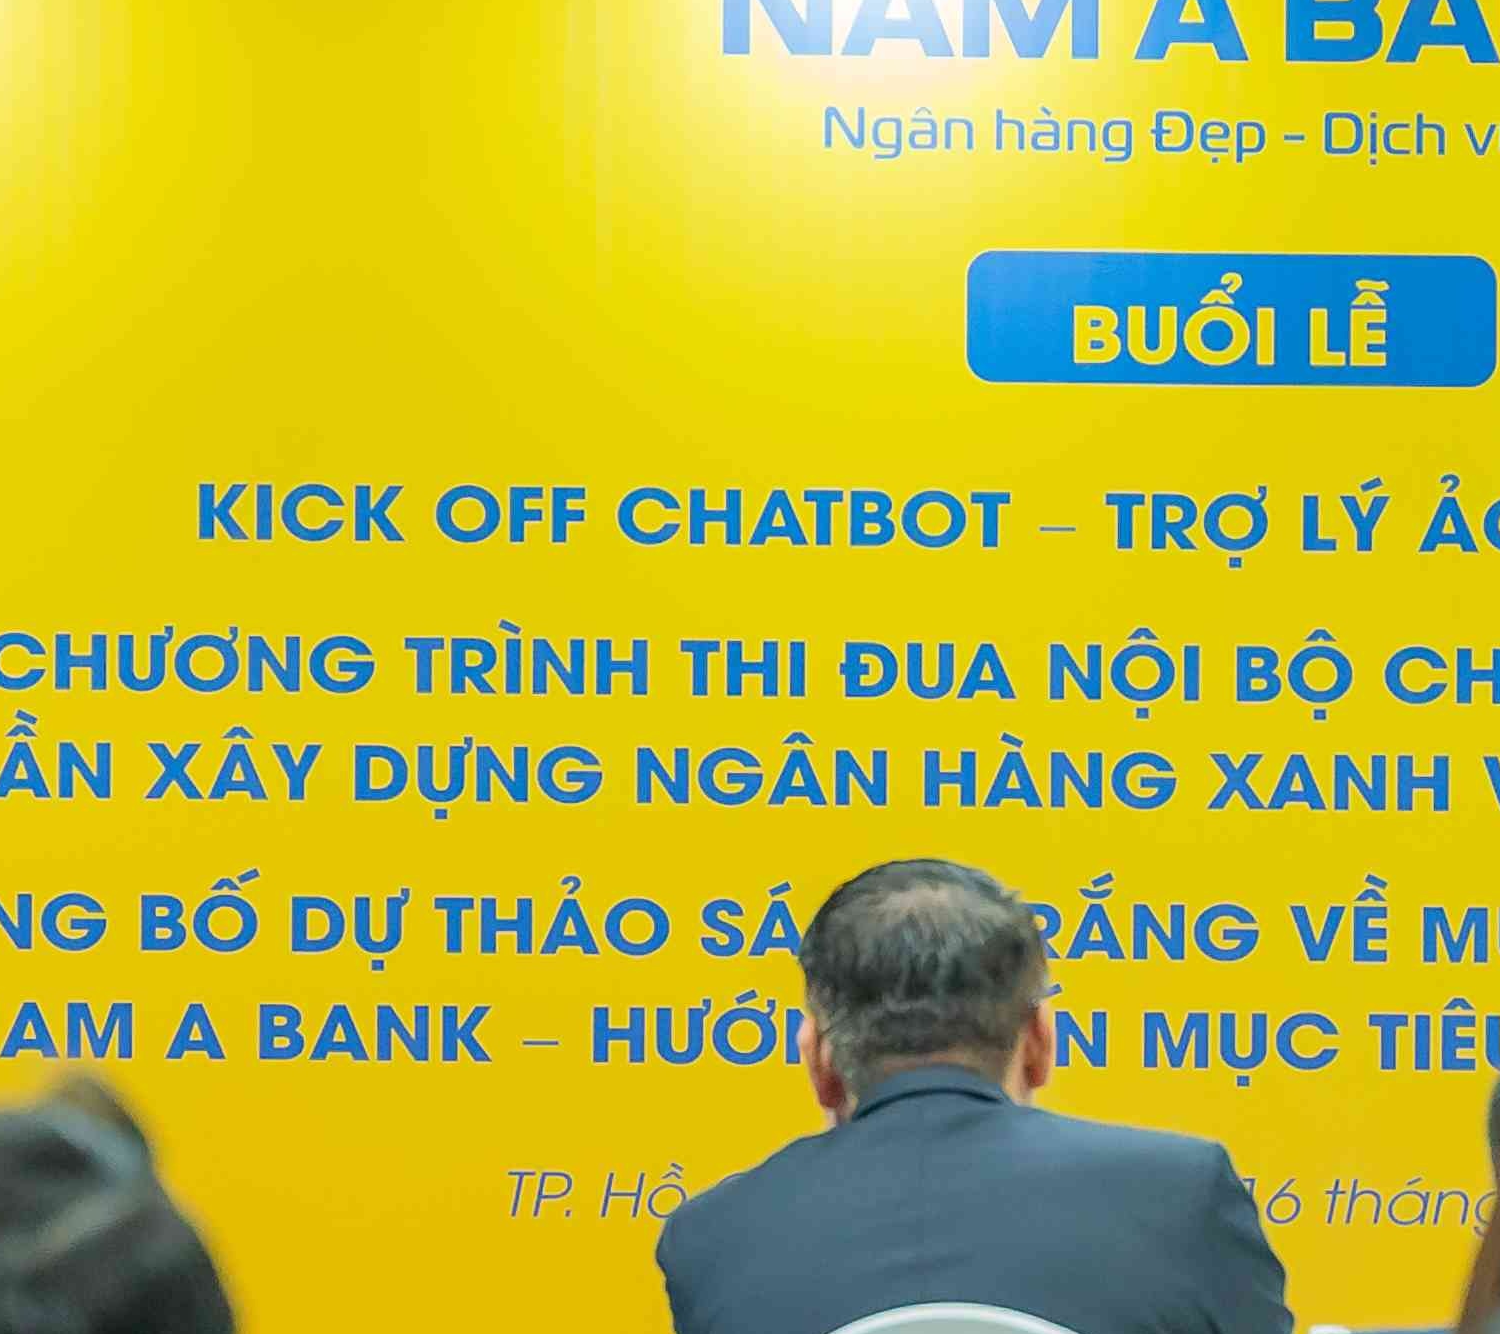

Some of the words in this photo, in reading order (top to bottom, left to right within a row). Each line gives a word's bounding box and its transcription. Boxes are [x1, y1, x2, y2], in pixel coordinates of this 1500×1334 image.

[823, 106, 974, 159] Ngân
[995, 110, 1133, 162] hàng
[1151, 110, 1265, 163] Đẹp
[1324, 112, 1445, 160] Dịch
[1073, 272, 1275, 366] BUỔI
[1309, 279, 1389, 367] LỄ
[198, 482, 404, 542] KICK
[434, 485, 586, 544] OFF
[617, 487, 1011, 549] CHATBOT
[1105, 486, 1268, 568] TRỢ
[1303, 478, 1389, 553] LÝ
[403, 620, 649, 696] TRÌNH
[679, 640, 806, 698] THI
[838, 642, 1016, 701] ĐUA
[1048, 626, 1201, 720] NỘI
[1235, 628, 1353, 721] BỘ
[146, 725, 322, 801] XÂY
[353, 735, 604, 820] DỰNG
[636, 731, 889, 807] NGÂN
[923, 732, 1177, 811] HÀNG
[1208, 752, 1450, 813] XANH
[140, 869, 260, 953] BỐ
[290, 887, 410, 972] DỰ
[433, 874, 670, 957] THẢO
[1023, 872, 1259, 962] RẮNG
[1290, 873, 1388, 964] VỀ
[166, 1002, 225, 1060] A
[258, 1003, 491, 1063] BANK
[1142, 1011, 1338, 1088] MỤC
[507, 1170, 573, 1218] TP.
[600, 1161, 687, 1219] Hồ
